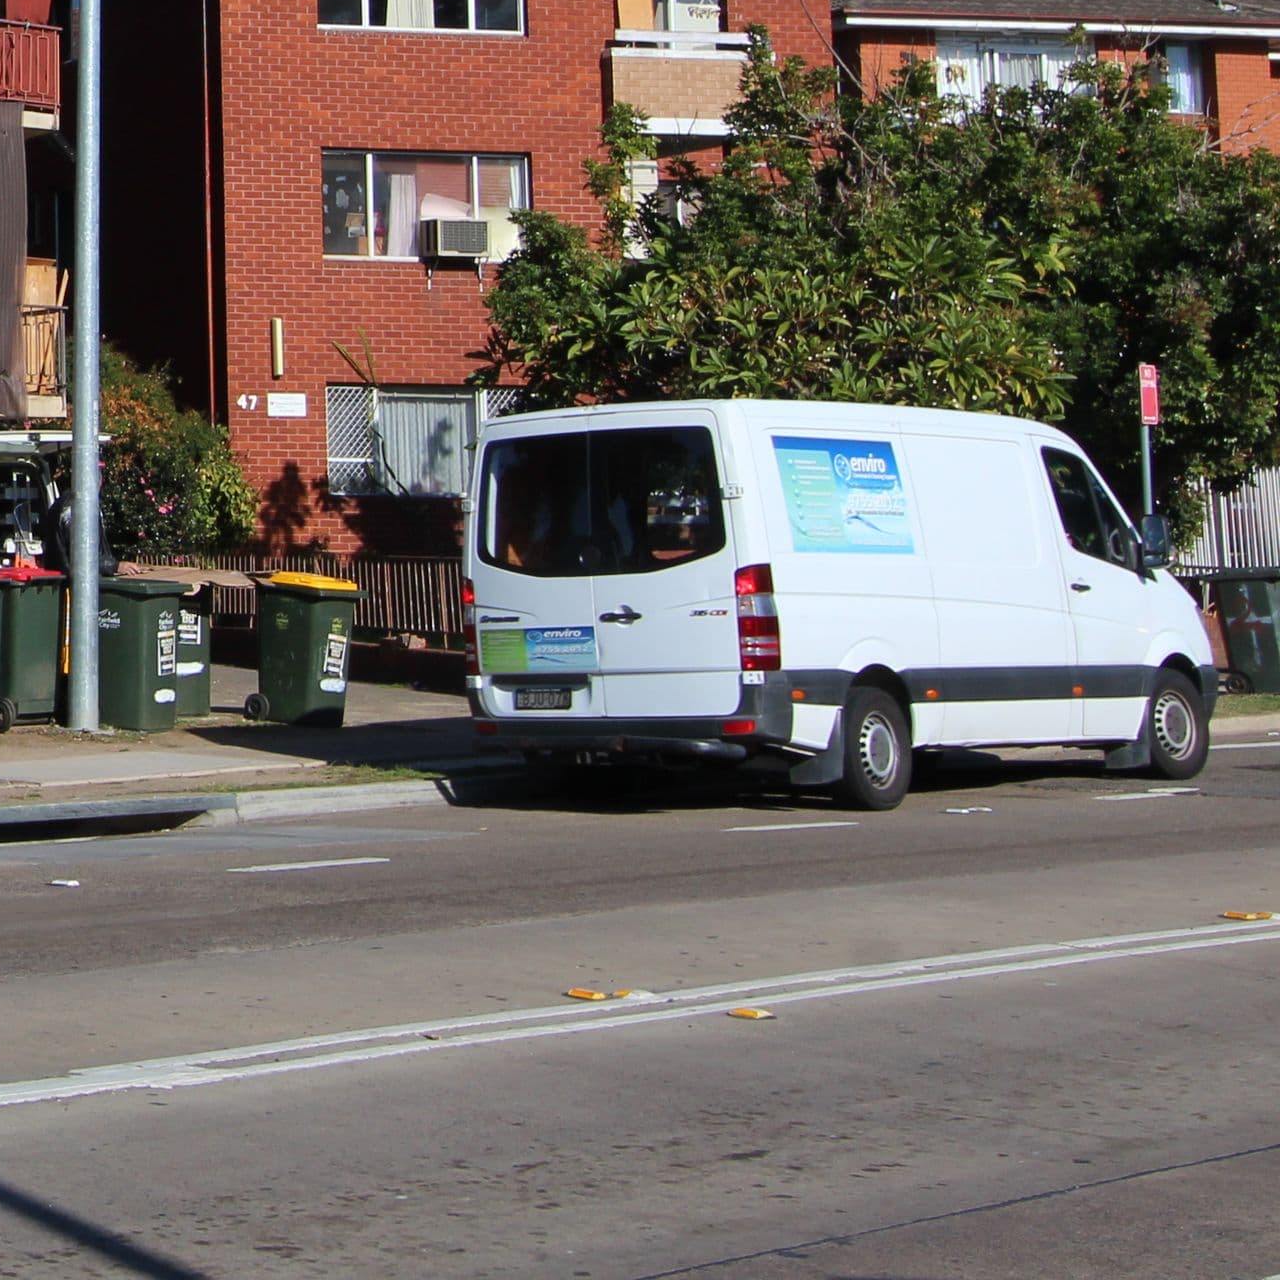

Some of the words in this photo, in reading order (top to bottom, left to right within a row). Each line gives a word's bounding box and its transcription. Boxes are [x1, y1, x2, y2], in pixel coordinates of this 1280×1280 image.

[237, 394, 258, 410] 47
[850, 453, 886, 473] enviro
[543, 628, 582, 638] enviro
